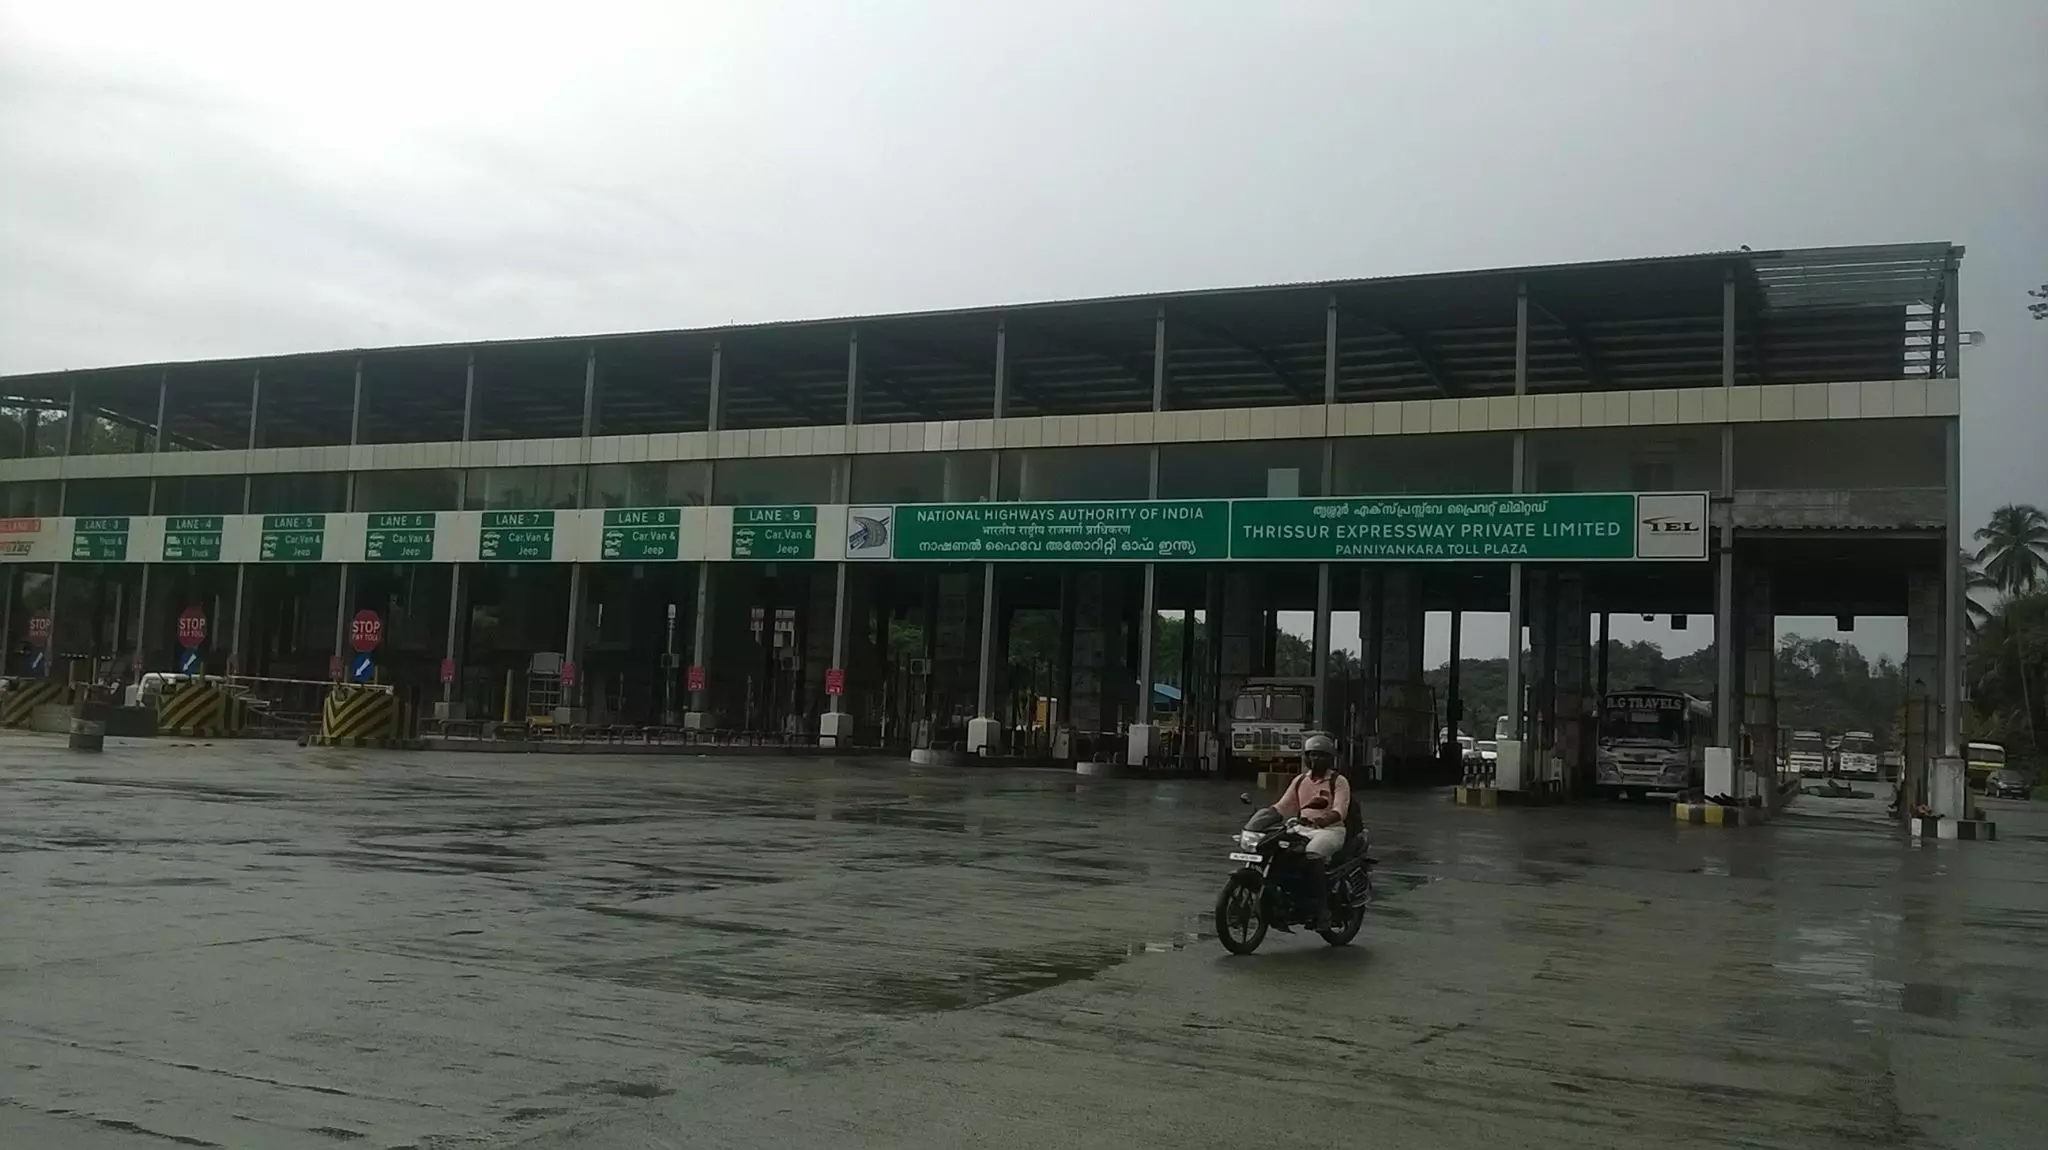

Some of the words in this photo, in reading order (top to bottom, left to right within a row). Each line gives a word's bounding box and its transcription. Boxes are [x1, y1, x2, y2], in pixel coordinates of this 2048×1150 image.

[496, 515, 524, 525] LANE
[533, 514, 540, 524] 7
[618, 512, 648, 523] LANE
[657, 511, 665, 522] 8
[749, 510, 781, 521] LANE
[792, 509, 800, 521] 9
[917, 510, 981, 521] NATIONAL
[984, 509, 1055, 521] HIGHWAYS
[1059, 508, 1137, 520] AUTHORITY
[1140, 508, 1159, 520] OF
[1162, 507, 1204, 519] INDIA
[84, 519, 107, 529] LANE
[176, 519, 199, 529] LANE
[206, 519, 212, 528] 4
[274, 518, 299, 528] LANE
[306, 518, 313, 527] 5
[380, 516, 408, 526] LANE
[415, 515, 421, 526] 6
[982, 522, 1016, 535] भारतीय
[1047, 522, 1083, 535] राजमार्ग
[1085, 522, 1131, 535] प्राधिकरण
[1242, 525, 1329, 539] THRISSUR
[1336, 524, 1455, 538] EXPRESSWAY
[1461, 523, 1535, 538] PRIVATE
[1543, 522, 1621, 537] LIMITED
[543, 532, 550, 542] &
[669, 531, 676, 541] &
[805, 529, 812, 540] &
[292, 547, 311, 557] Jeep
[399, 547, 420, 556] Jeep
[517, 546, 539, 556] Jeep
[642, 545, 664, 555] Jeep
[776, 544, 800, 555] Jeep
[1335, 544, 1444, 555] PANNIYANKARA
[1447, 544, 1480, 554] TOLL
[1484, 544, 1528, 554] PLAZA
[30, 618, 50, 629] STOP
[179, 618, 205, 630] STOP
[352, 620, 380, 633] STOP
[1628, 697, 1683, 710] TRAVELS
